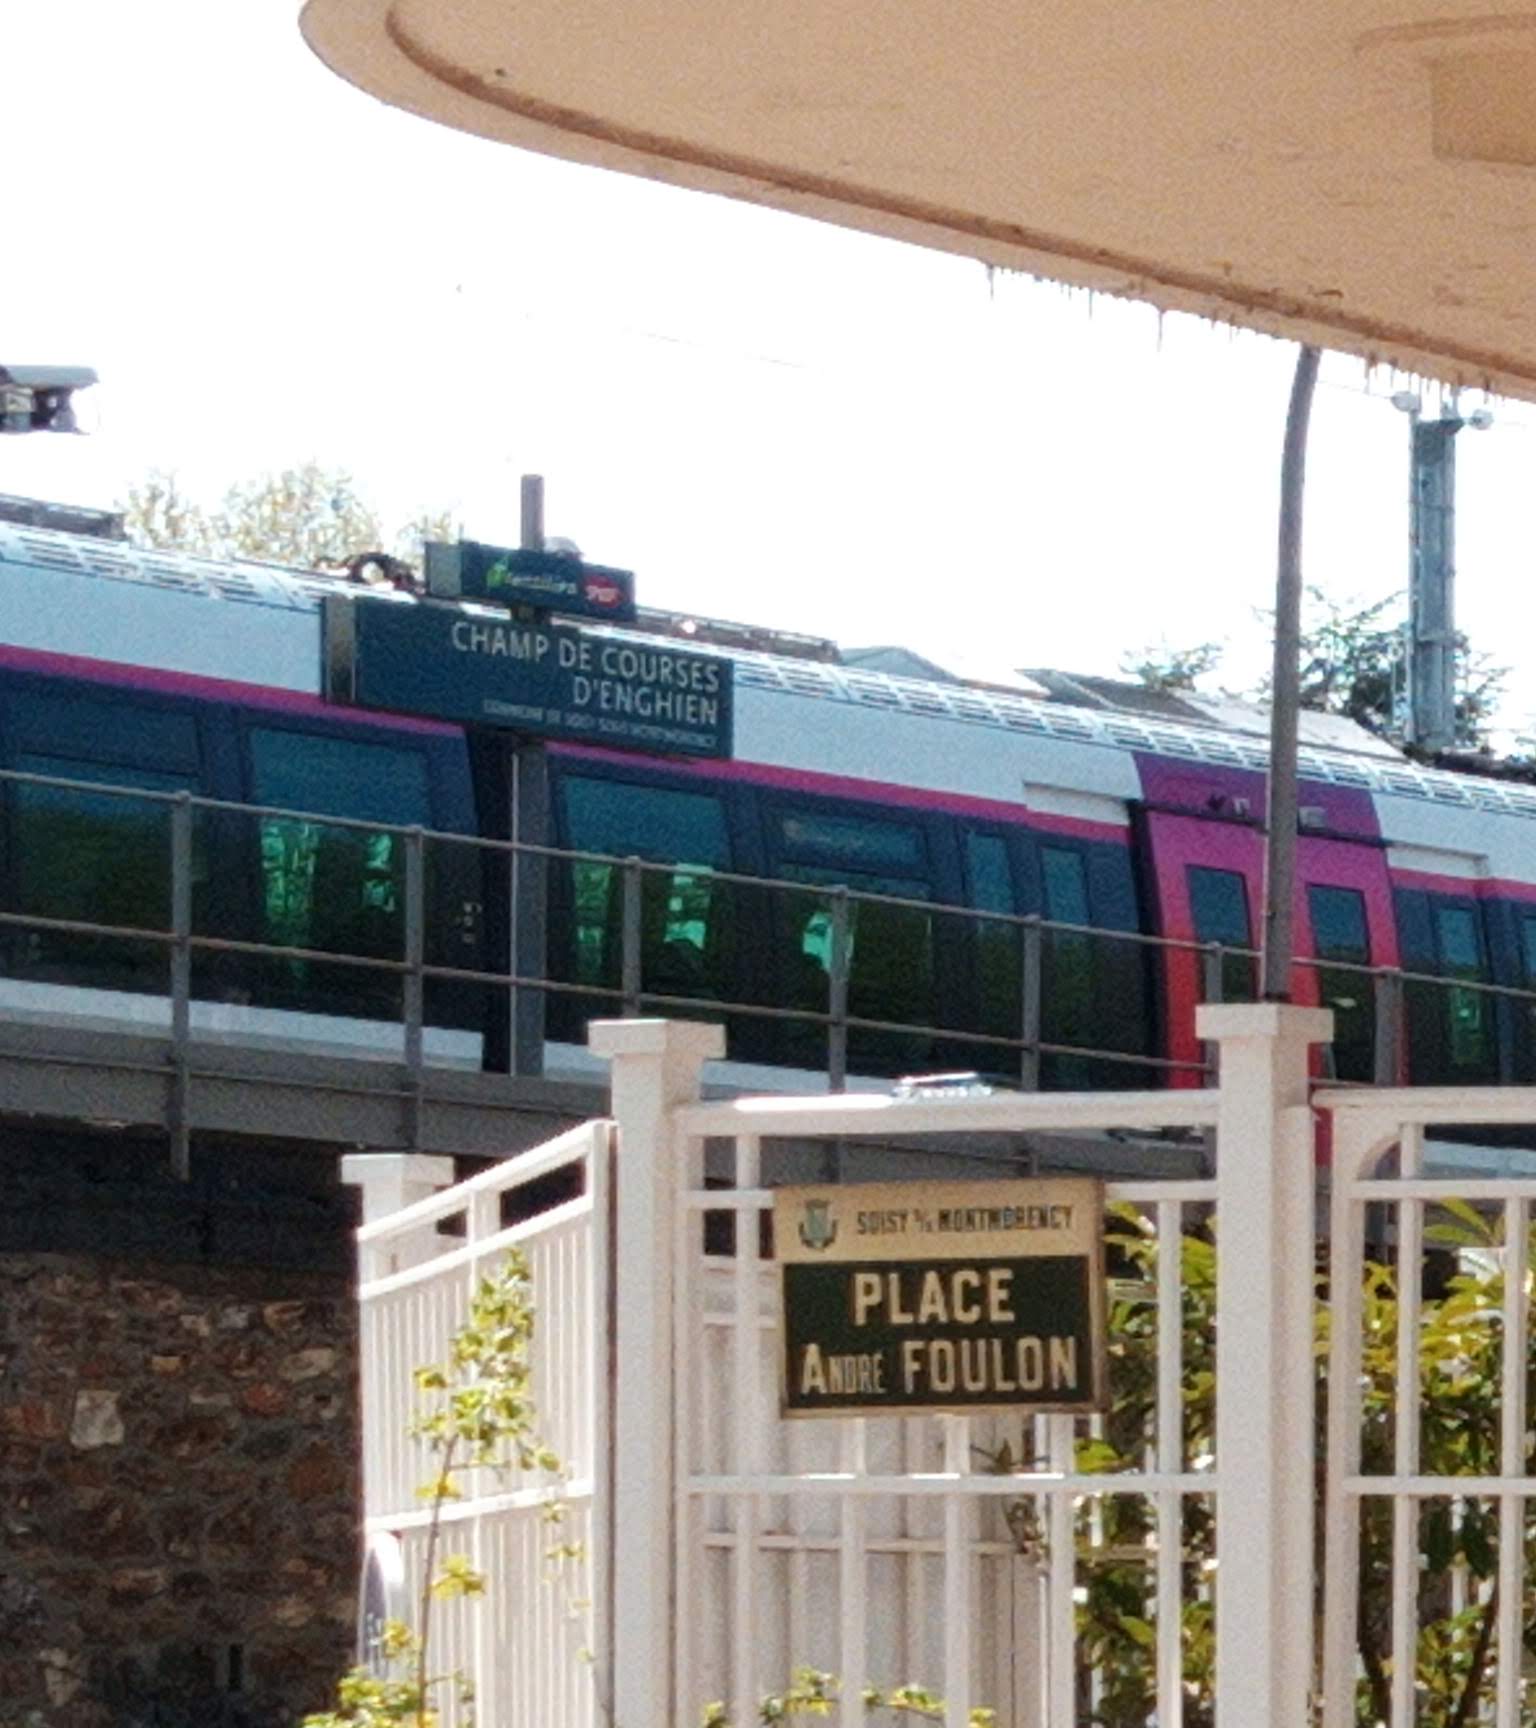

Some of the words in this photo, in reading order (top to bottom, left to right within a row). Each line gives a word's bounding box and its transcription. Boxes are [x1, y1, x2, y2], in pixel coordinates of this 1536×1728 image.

[452, 621, 549, 662] CHAMP
[558, 638, 593, 671] DE
[602, 647, 720, 693] COURSES
[572, 675, 718, 725] D'ENGHIEN
[856, 1208, 909, 1235] SOISY
[853, 1267, 1016, 1327] PLACE
[902, 1335, 1079, 1394] FOULON
